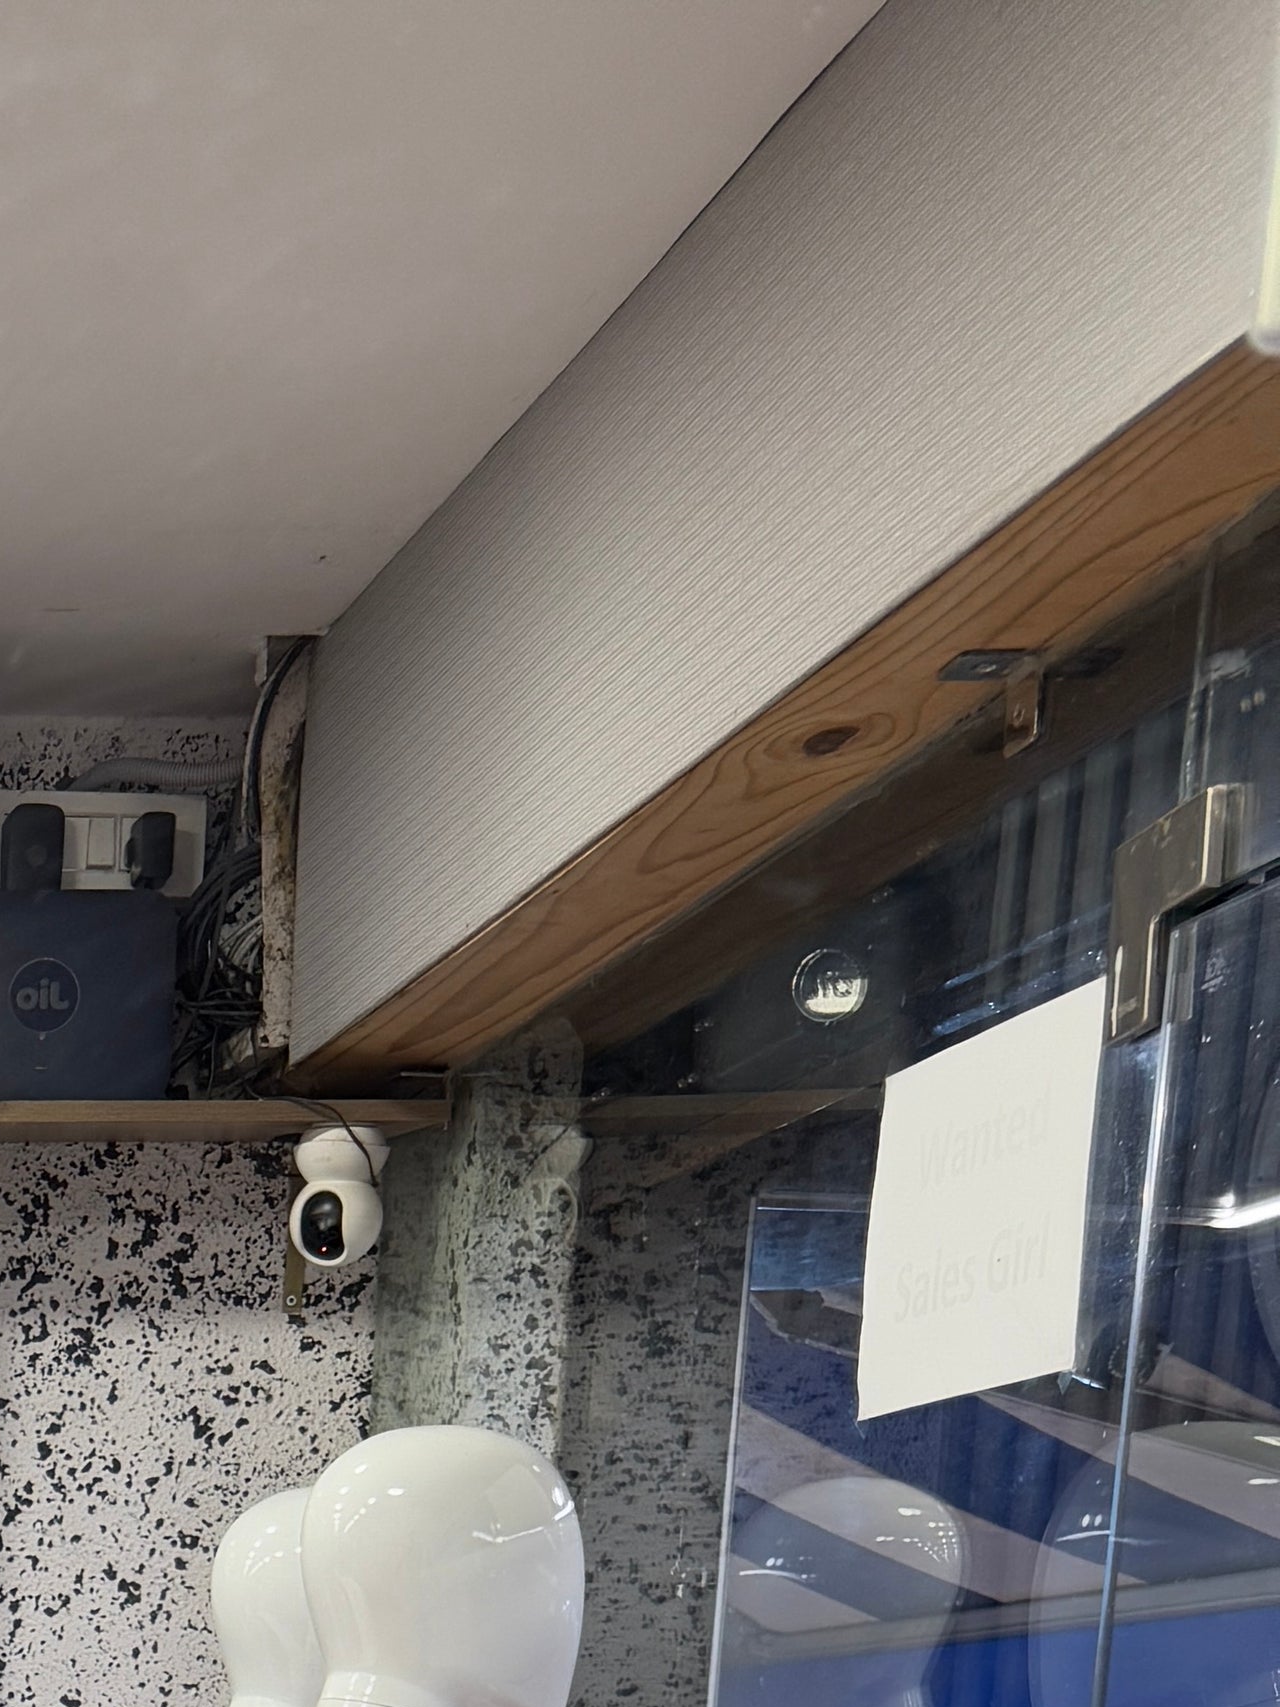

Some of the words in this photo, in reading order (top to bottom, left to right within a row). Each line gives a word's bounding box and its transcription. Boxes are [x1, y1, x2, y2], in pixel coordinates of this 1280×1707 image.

[919, 1080, 1052, 1190] Wanted
[893, 1240, 977, 1324] Sales
[986, 1210, 1051, 1294] Girl
